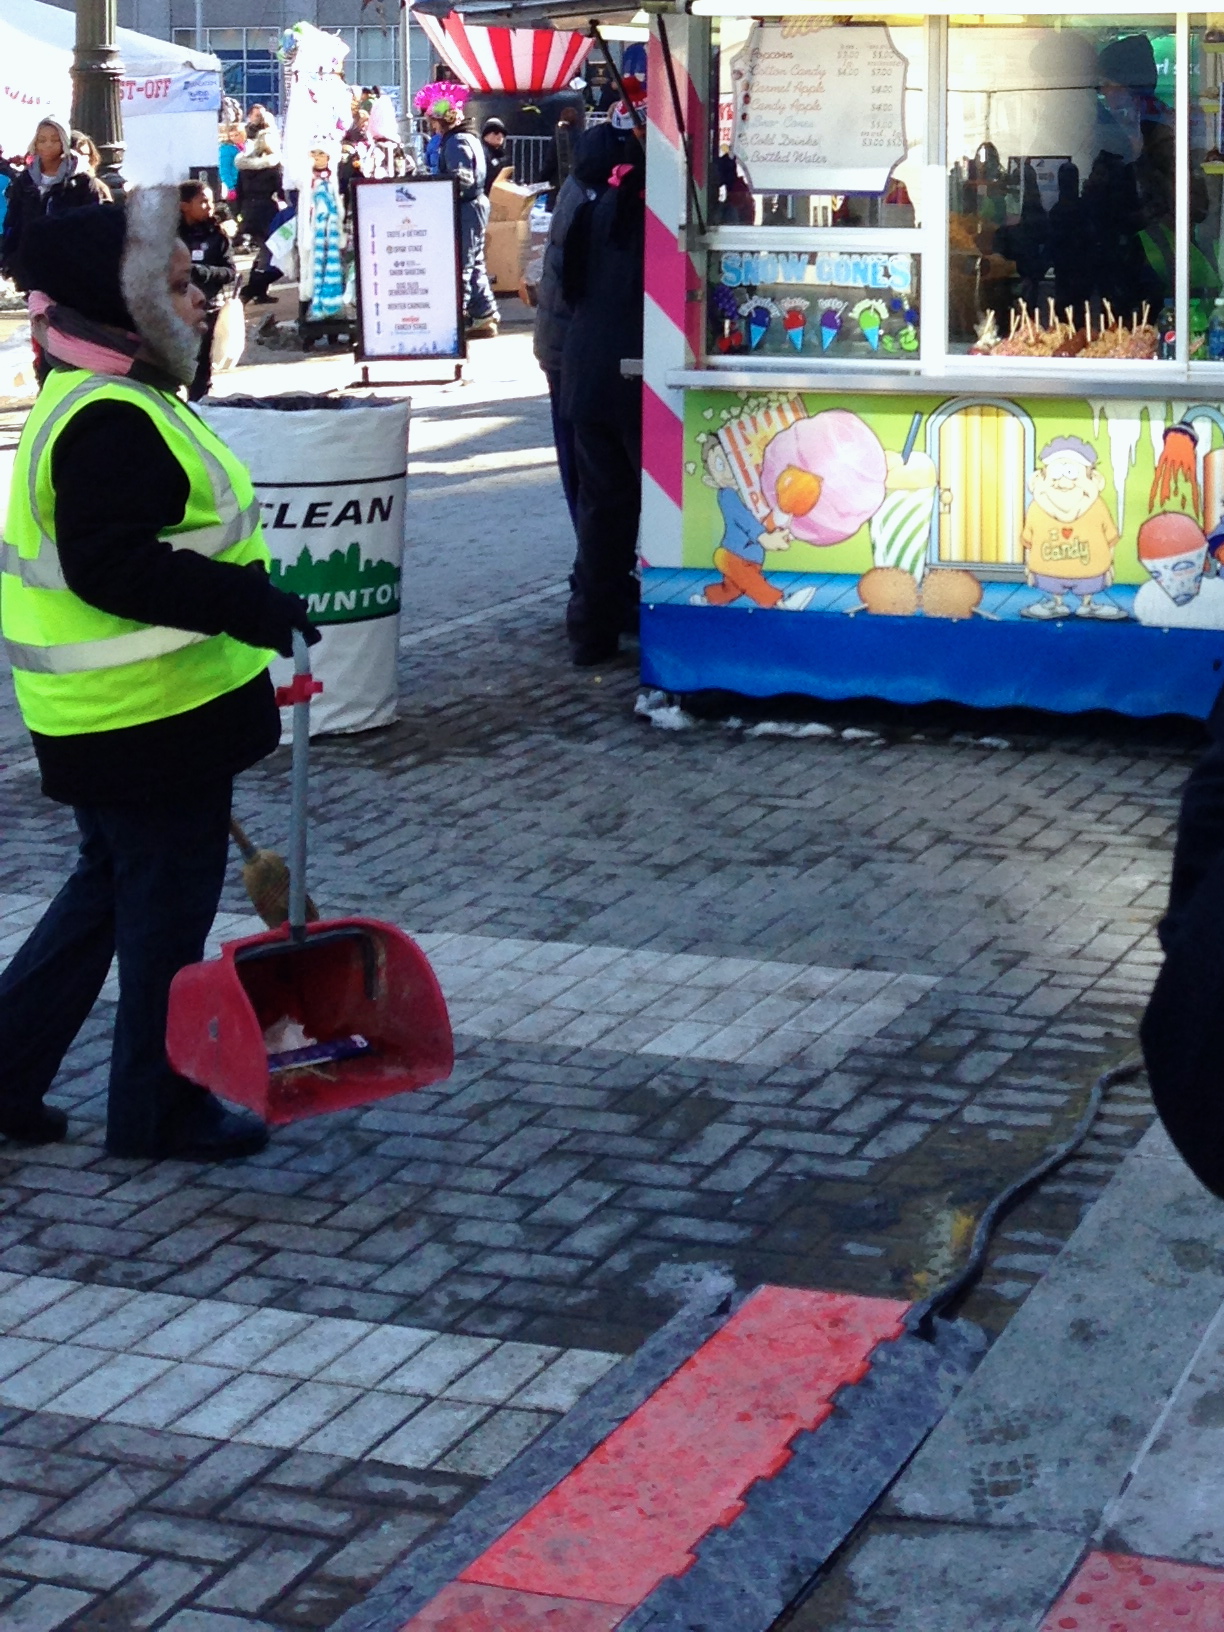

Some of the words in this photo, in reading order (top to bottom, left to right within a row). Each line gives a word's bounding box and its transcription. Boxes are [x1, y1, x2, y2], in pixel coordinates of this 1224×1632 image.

[751, 152, 791, 163] Bottled
[793, 152, 827, 164] Water
[721, 251, 809, 287] SNOW
[814, 253, 912, 293] CONES
[1041, 536, 1091, 566] Candy
